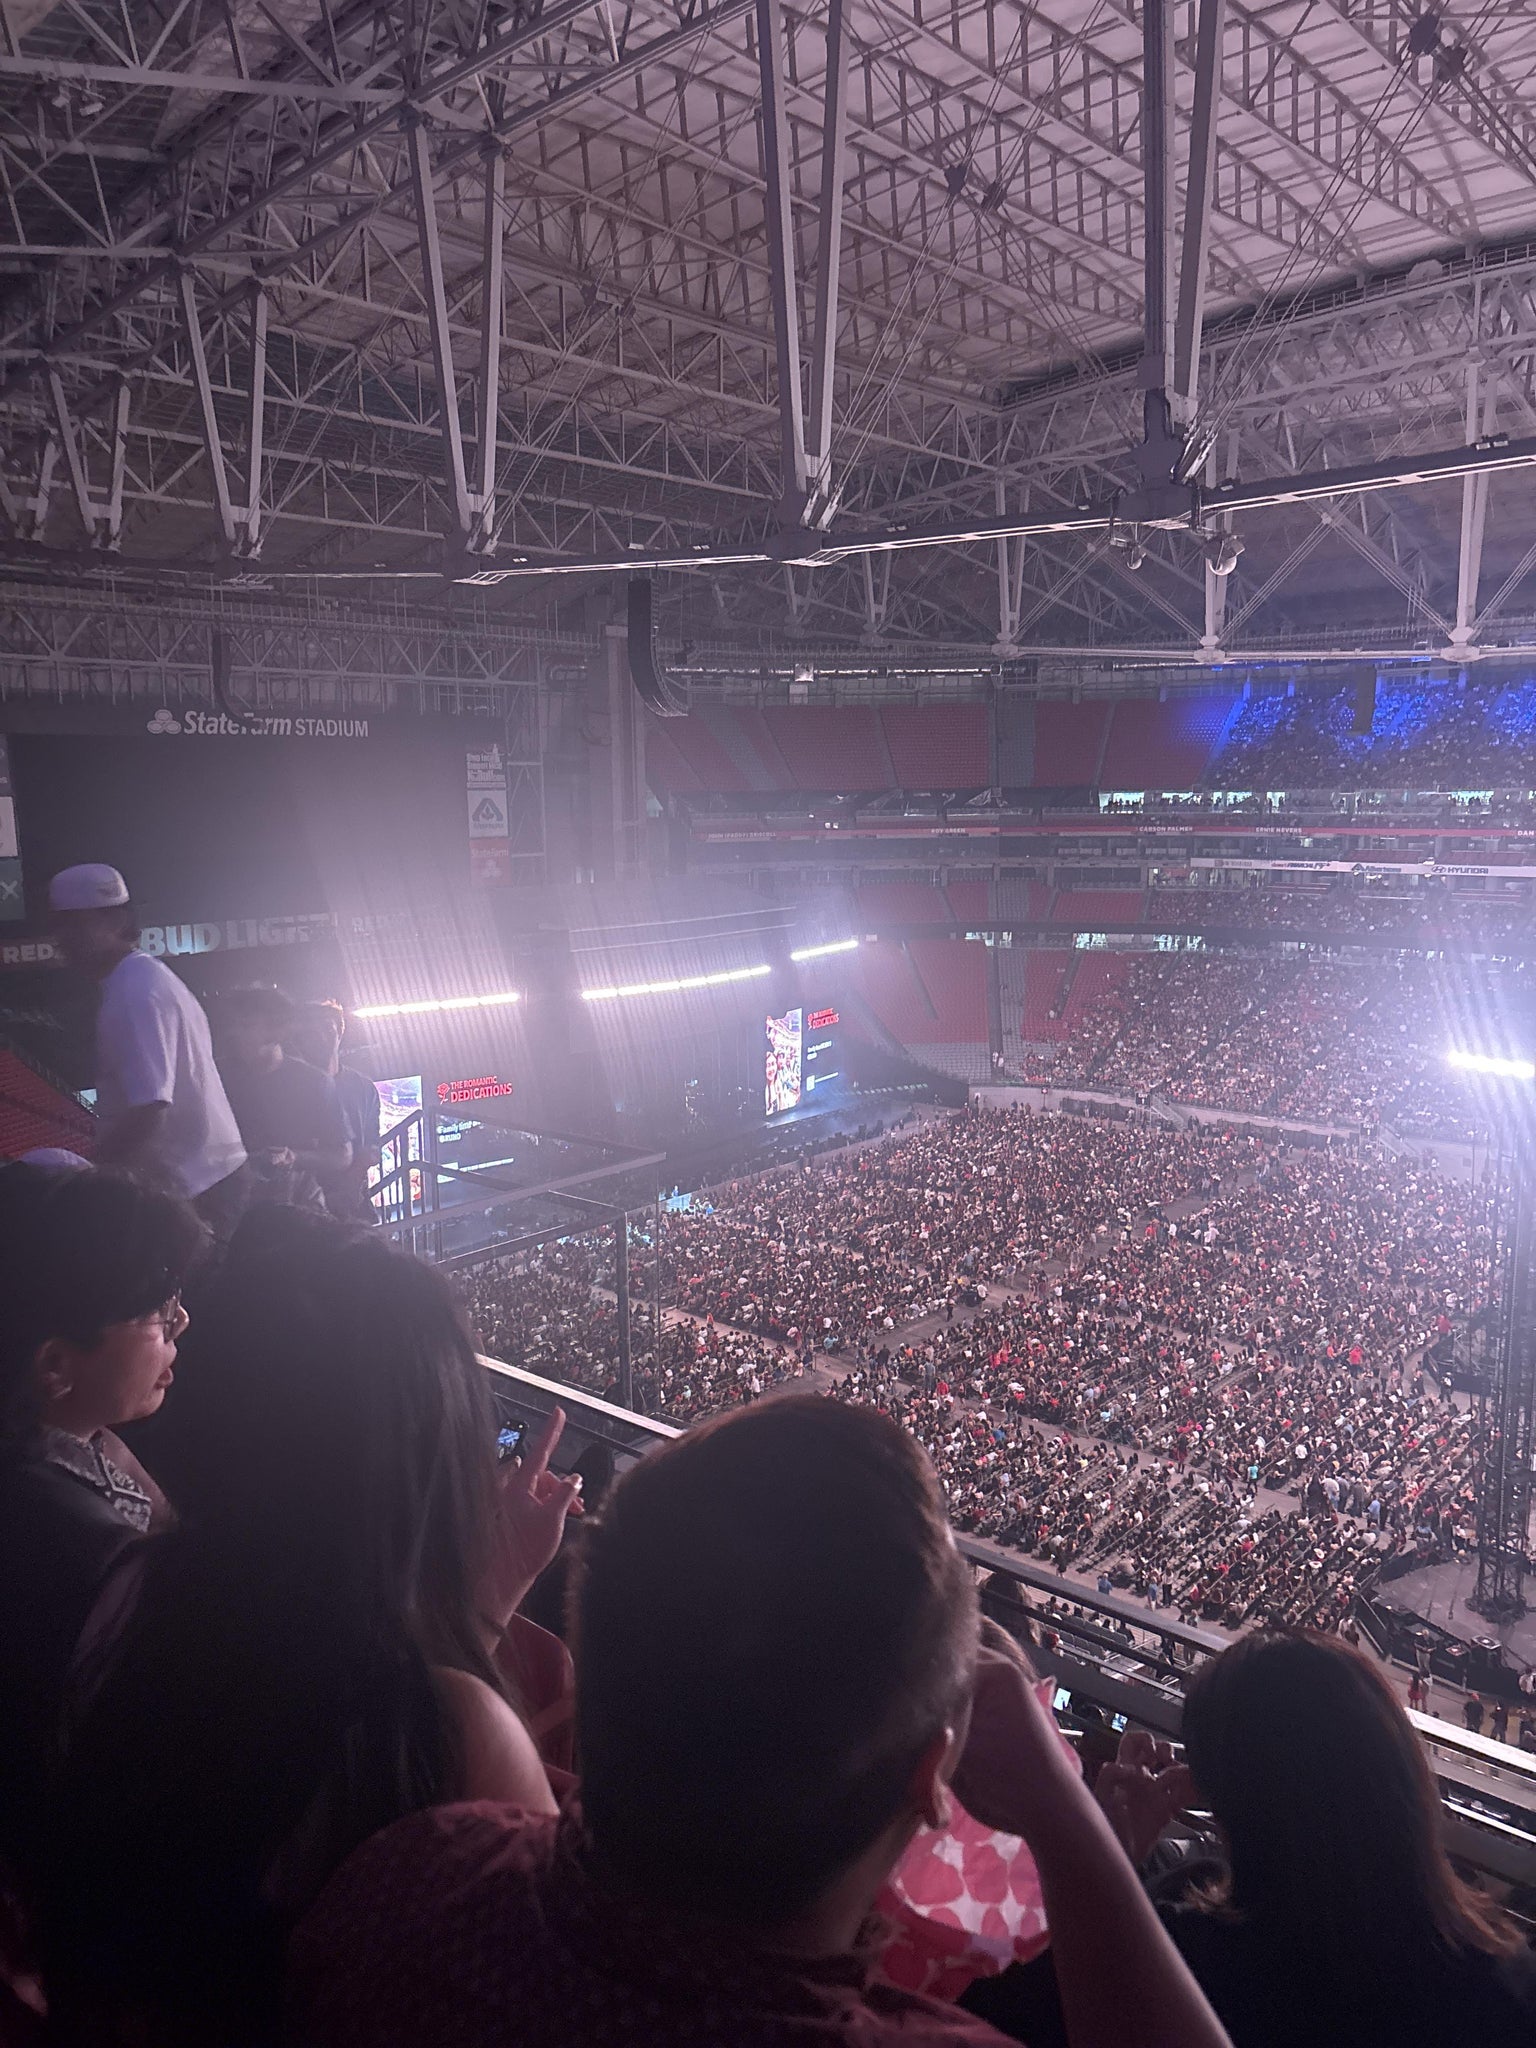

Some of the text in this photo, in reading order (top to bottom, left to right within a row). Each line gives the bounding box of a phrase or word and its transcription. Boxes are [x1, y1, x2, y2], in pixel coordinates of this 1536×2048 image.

[295, 718, 369, 737] STADIUM
[1447, 866, 1489, 875] HYUNDAI
[140, 923, 221, 956] BUD
[450, 1075, 498, 1090] THE ROMANTIC
[450, 1082, 513, 1103] DEDICATIONS
